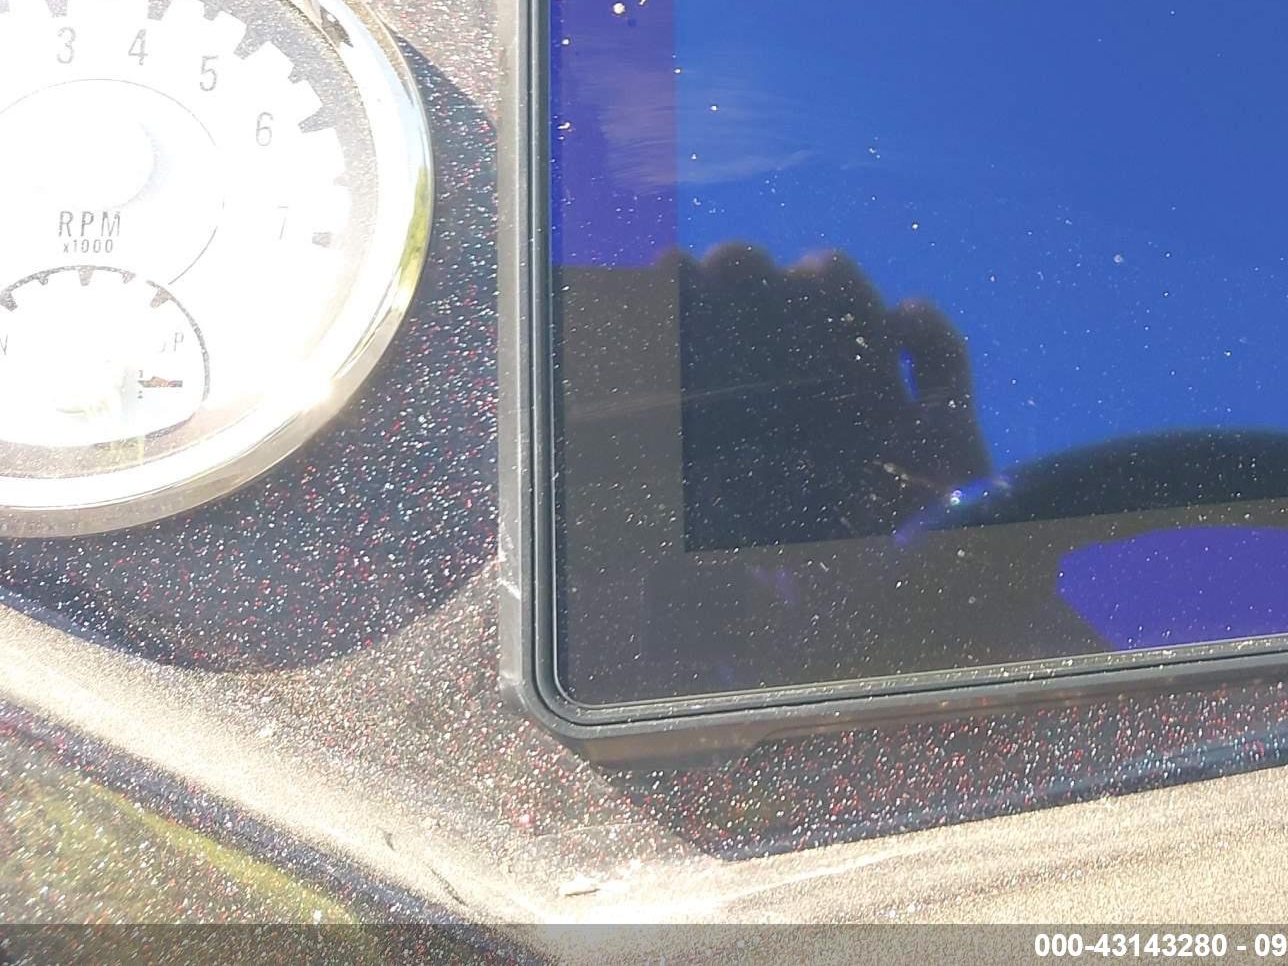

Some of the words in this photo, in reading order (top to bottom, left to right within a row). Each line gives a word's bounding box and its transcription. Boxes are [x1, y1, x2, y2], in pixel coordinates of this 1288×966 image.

[55, 27, 77, 65] 3
[127, 28, 149, 66] 4
[199, 55, 219, 92] 5
[255, 111, 275, 147] 6
[57, 210, 121, 238] RPM
[277, 205, 290, 241] 7
